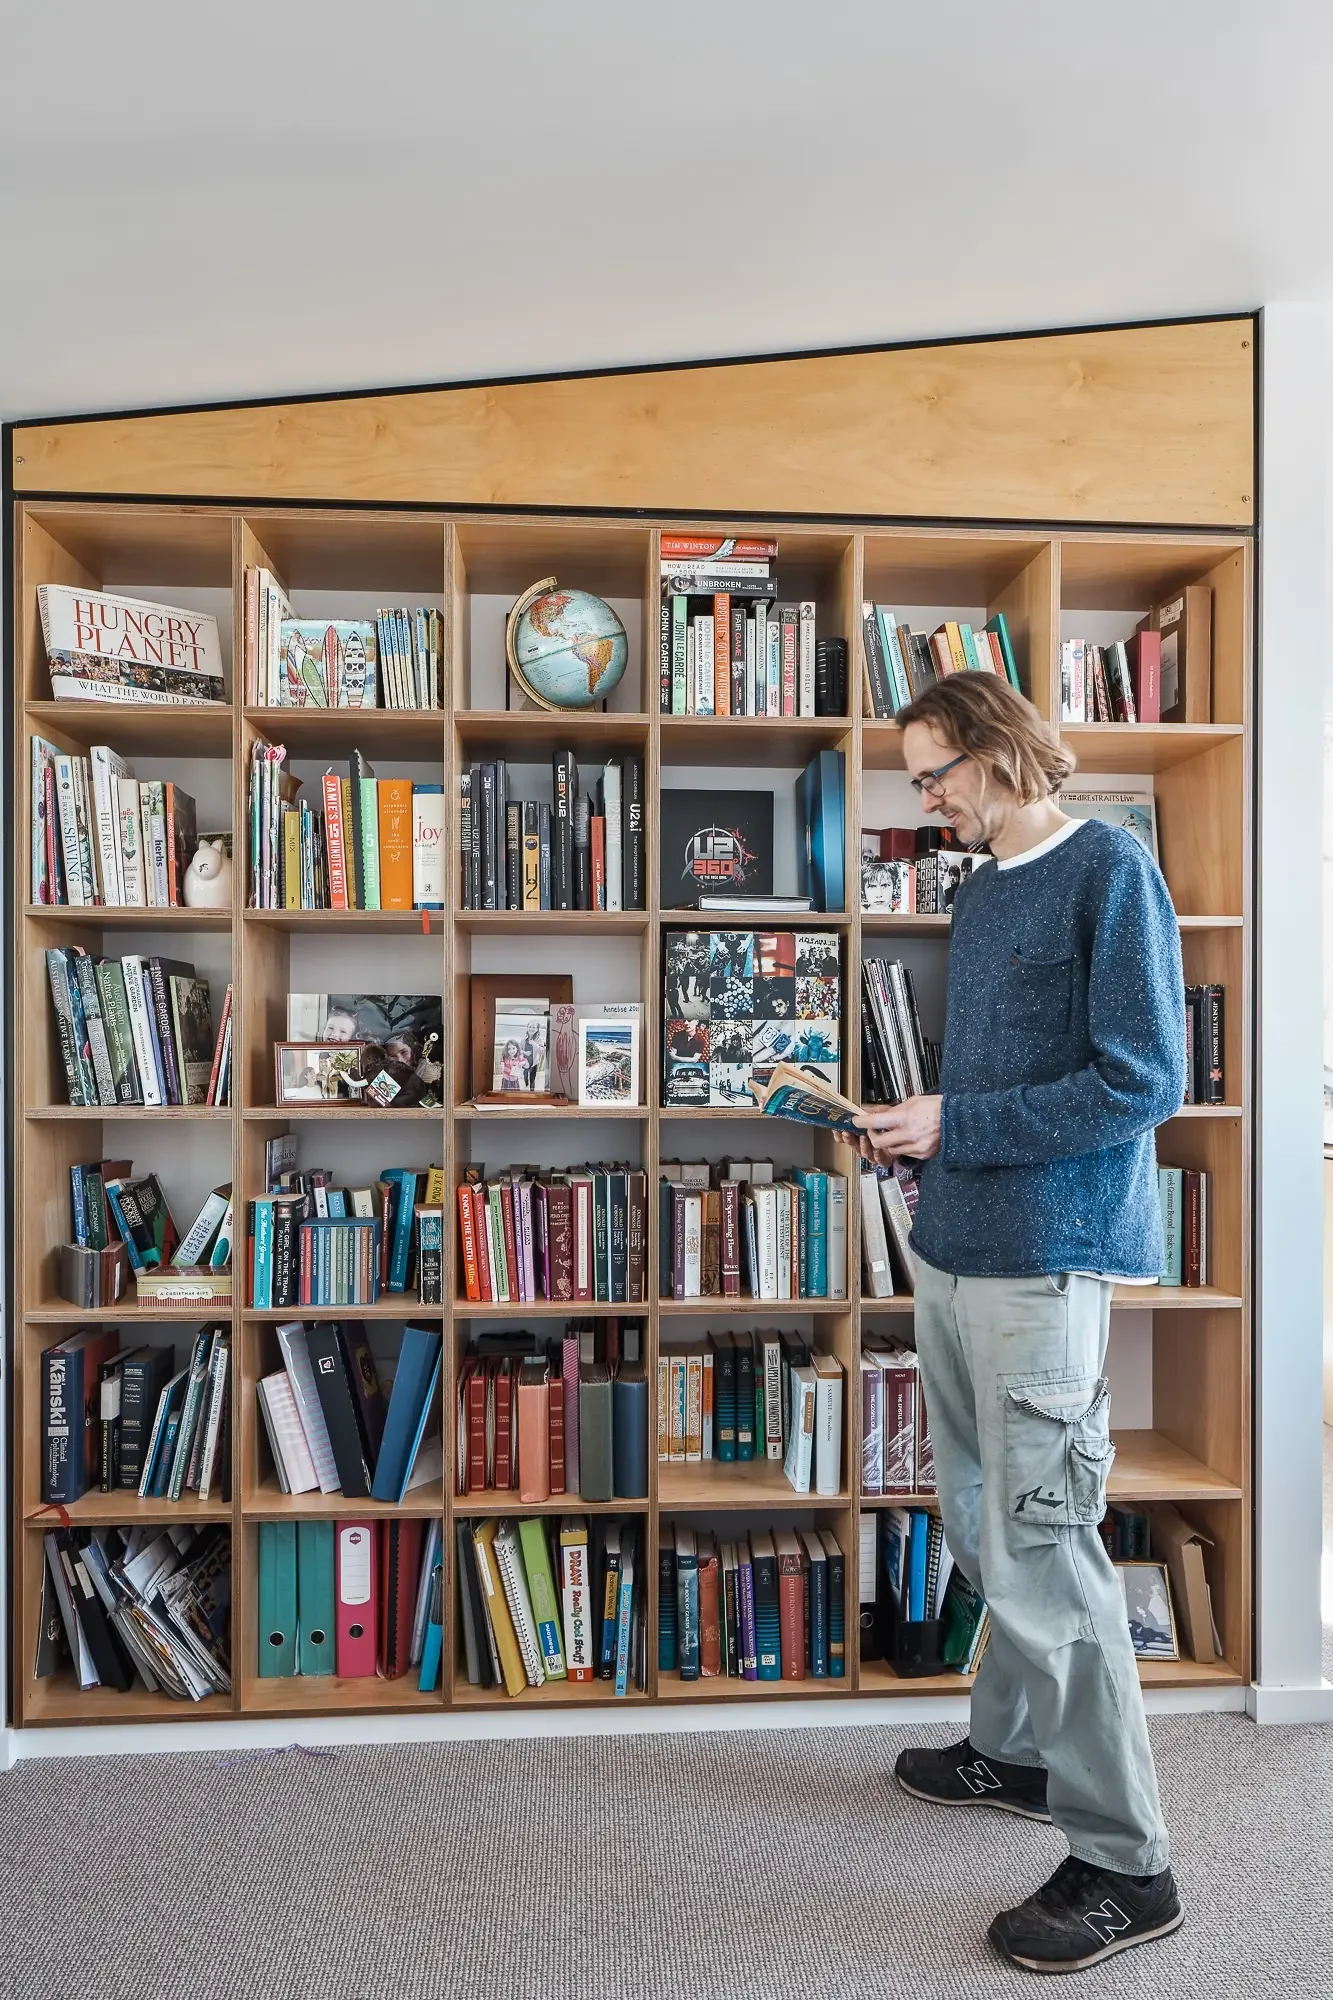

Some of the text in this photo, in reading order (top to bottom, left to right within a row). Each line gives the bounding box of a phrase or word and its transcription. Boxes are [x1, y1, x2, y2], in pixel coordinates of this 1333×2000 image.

[72, 598, 204, 647] HUNGRY
[661, 605, 669, 631] JOHN
[716, 598, 727, 622] HARPER
[717, 624, 727, 634] LEE
[73, 623, 206, 671] PLANET
[661, 642, 670, 676] CARRÉ
[675, 620, 687, 678] JOHN LE CARRÉ
[717, 642, 727, 651] GO
[717, 654, 728, 663] SET
[890, 636, 909, 701] Reformation Thought
[78, 680, 114, 694] WHAT
[114, 686, 138, 698] THE
[140, 690, 180, 704] WORLD
[717, 671, 728, 708] WATCHMAN
[784, 682, 795, 698] ARK
[101, 812, 113, 860] HERBS
[127, 816, 135, 847] organic
[152, 818, 164, 868] grow herbs
[326, 780, 343, 894] JAMIE'S 15 MINUTE MEALS
[472, 829, 480, 858] U2 LIVE
[693, 836, 734, 860] U2
[63, 827, 80, 882] SEWING
[50, 960, 64, 1009] AUSTRALIAN
[58, 1008, 67, 1037] NATIVE
[102, 971, 117, 1027] Native Plants
[126, 962, 139, 1013] NATIVE GARDEN
[134, 978, 144, 1009] AUSTRALIAN
[156, 969, 166, 1002] NATIVE
[113, 984, 126, 1026] Australian
[159, 1003, 171, 1037] GARDEN
[726, 1191, 734, 1204] The
[1165, 1172, 1175, 1250] Greek Grammar Beyond Basics
[91, 1201, 100, 1233] DICTIONARY
[724, 1204, 734, 1237] Spreading
[184, 1224, 202, 1255] HEART
[191, 1226, 210, 1257] HAPPY
[258, 1208, 268, 1264] The Mothers' Group
[461, 1194, 476, 1285] KNOW THE TRUTH Milne
[283, 1251, 289, 1261] ON
[216, 1352, 226, 1382] COLOURED
[50, 1359, 67, 1425] Kanski
[213, 1382, 222, 1404] PENCILS
[767, 1365, 781, 1436] APPLICATION COMMENTARY
[49, 1438, 60, 1487] Ophthalmology
[60, 1437, 68, 1462] Clinical
[569, 1550, 584, 1665] DRAW Really Cool Stuff
[788, 1578, 796, 1630] DEUTERONOMY
[545, 1623, 555, 1655] Beautone
[956, 1760, 1002, 1794] N
[1082, 1898, 1132, 1944] N
